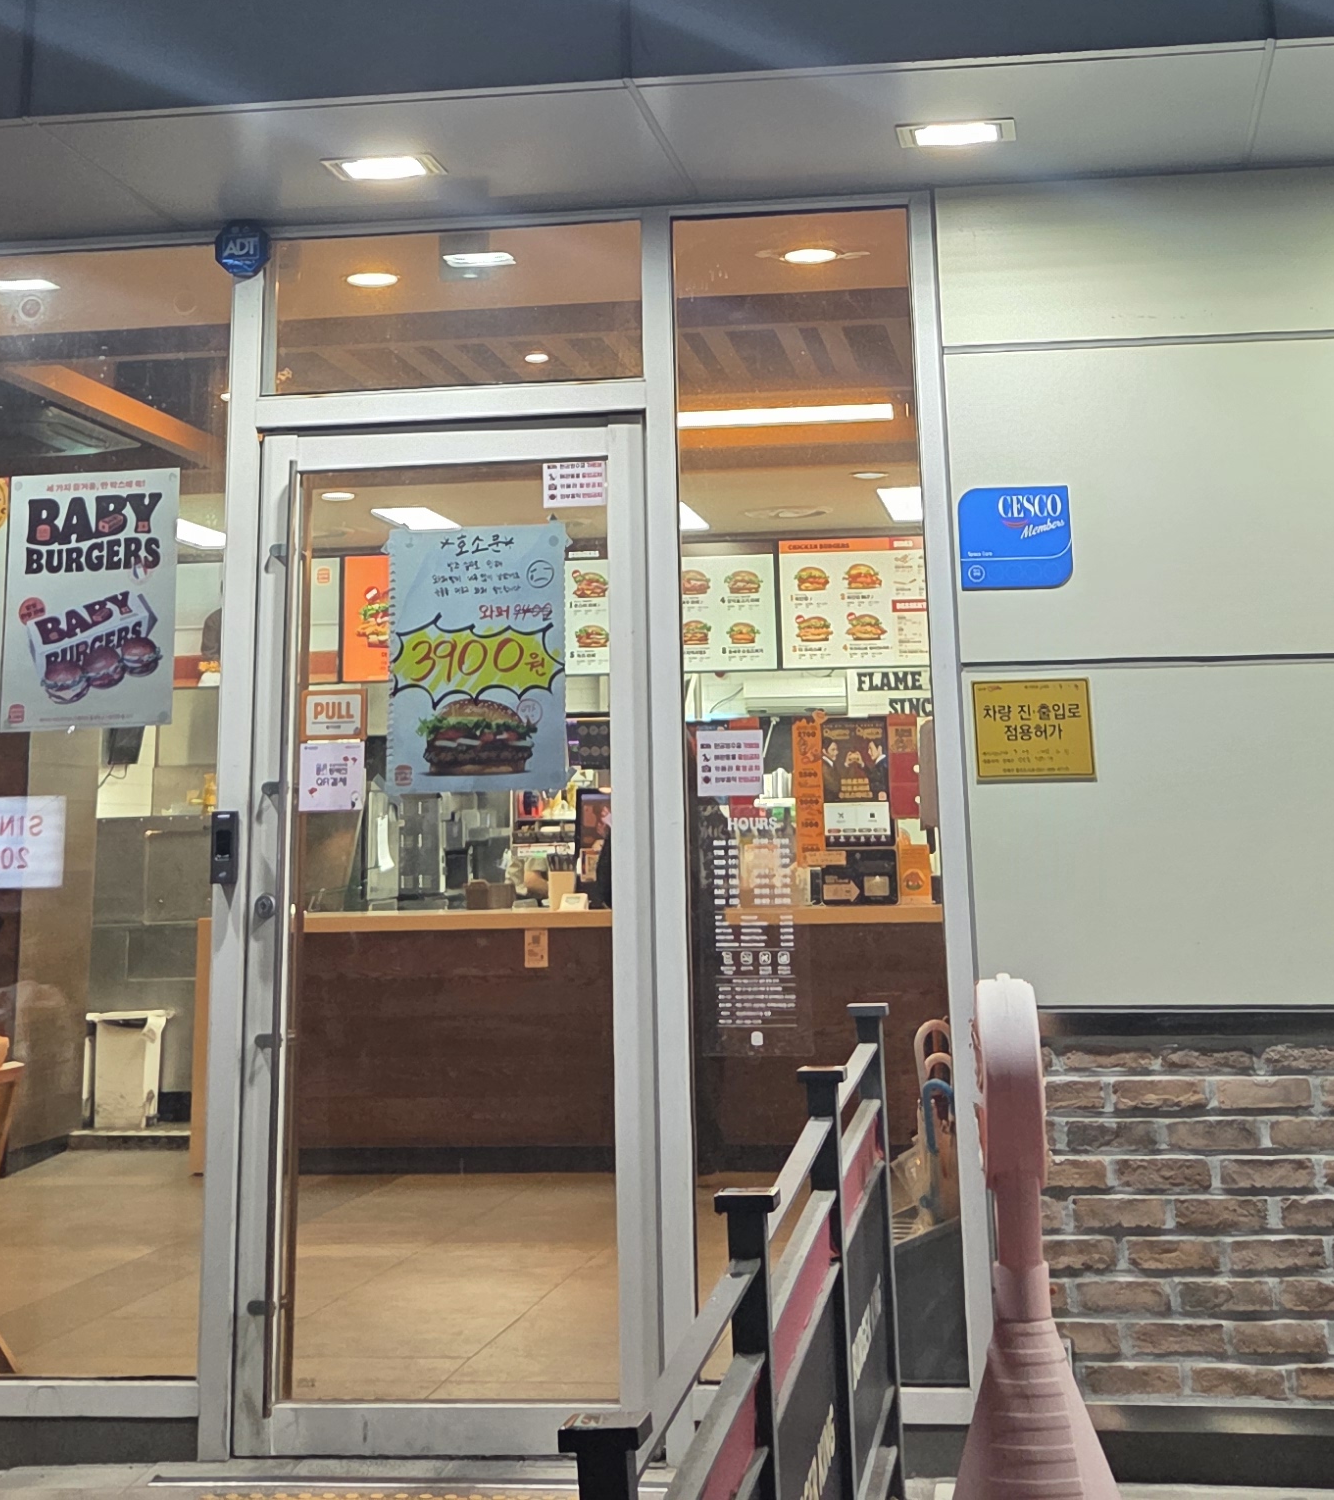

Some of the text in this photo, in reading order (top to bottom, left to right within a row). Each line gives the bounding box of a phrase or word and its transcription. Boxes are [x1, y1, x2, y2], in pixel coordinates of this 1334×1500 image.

[222, 237, 259, 257] ADT
[998, 493, 1062, 518] CESCO
[26, 492, 162, 546] BABY
[1020, 518, 1066, 539] Members
[455, 534, 502, 557] 호소문
[25, 537, 161, 575] BURGERS
[34, 591, 133, 645] BABY
[410, 637, 547, 683] 3900원
[856, 672, 923, 692] FLAME
[313, 701, 354, 720] PULL
[888, 697, 932, 715] SINC
[983, 704, 1012, 722] 차량
[1004, 723, 1063, 741] 점용허가
[727, 817, 778, 831] HOURS
